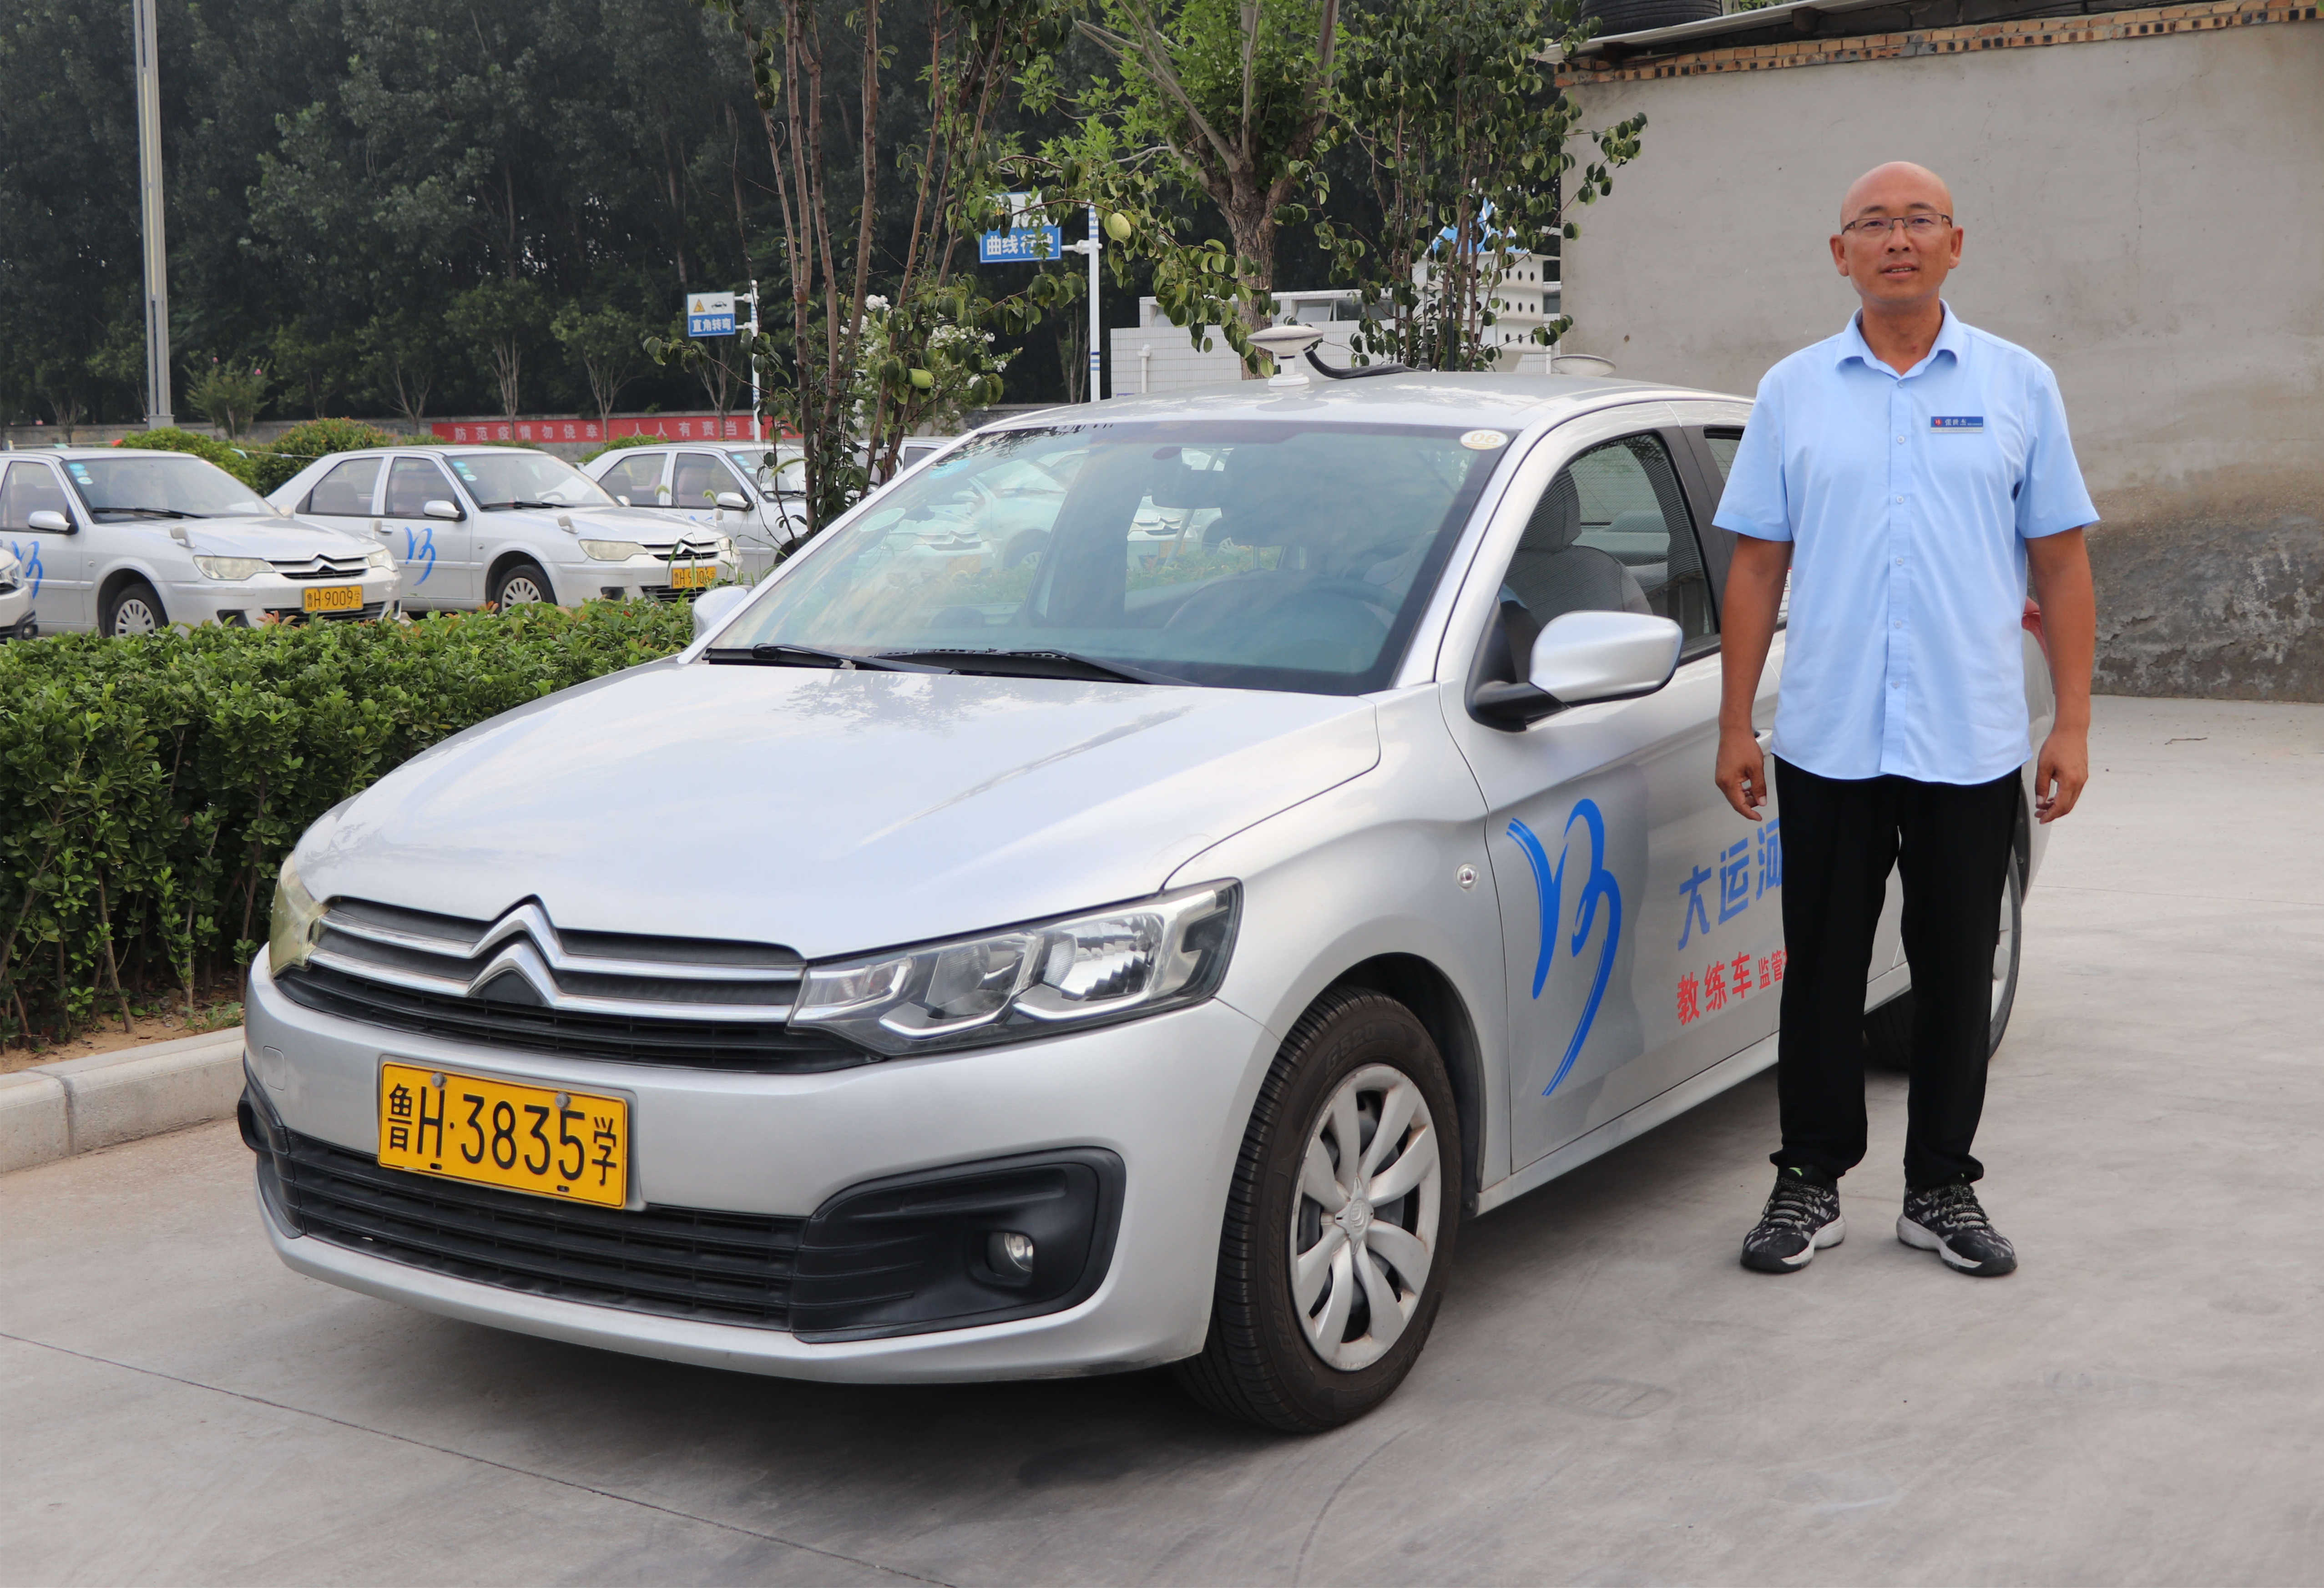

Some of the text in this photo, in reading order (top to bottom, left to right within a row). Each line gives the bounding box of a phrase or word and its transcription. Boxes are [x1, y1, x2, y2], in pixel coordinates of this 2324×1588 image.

[692, 318, 732, 333] 直角转弯
[1676, 945, 1788, 1026] 教练车 监管
